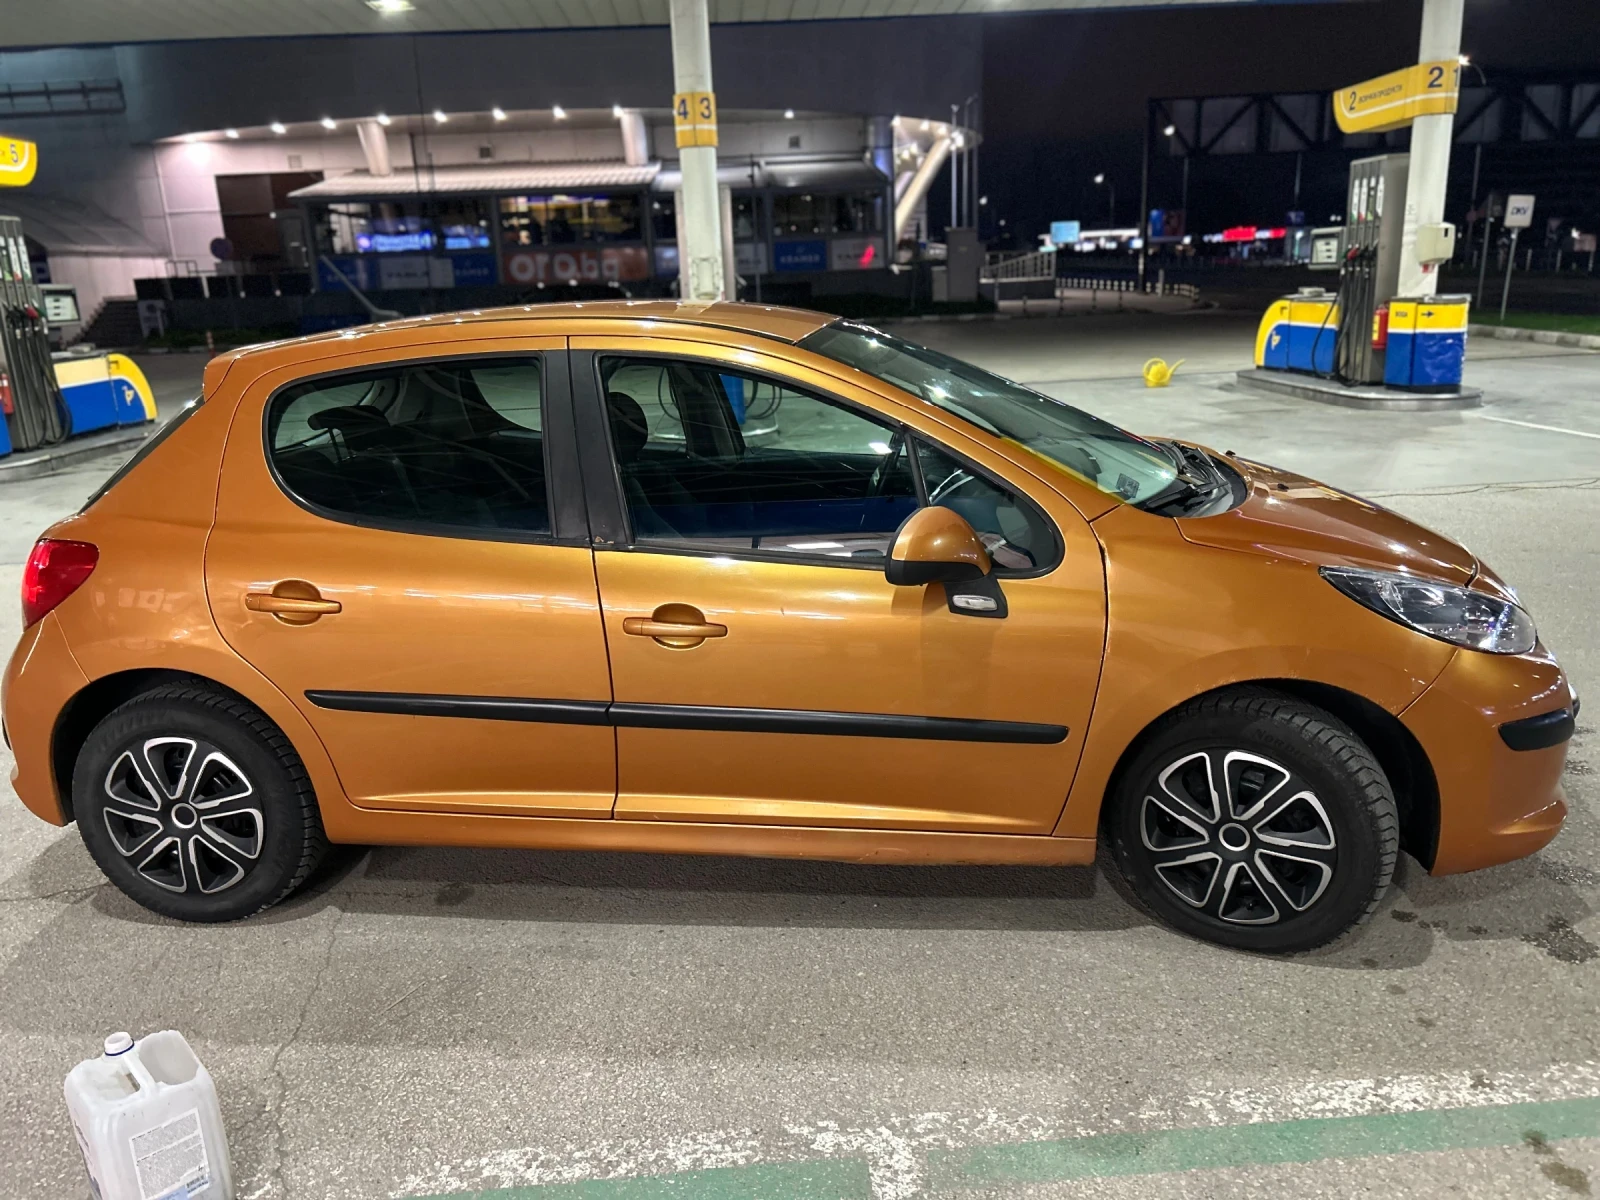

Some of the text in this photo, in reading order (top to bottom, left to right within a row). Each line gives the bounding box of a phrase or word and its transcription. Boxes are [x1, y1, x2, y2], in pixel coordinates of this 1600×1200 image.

[1427, 66, 1444, 88] 2
[677, 97, 712, 120] 4 3
[1349, 91, 1356, 110] 2
[10, 143, 19, 163] 5
